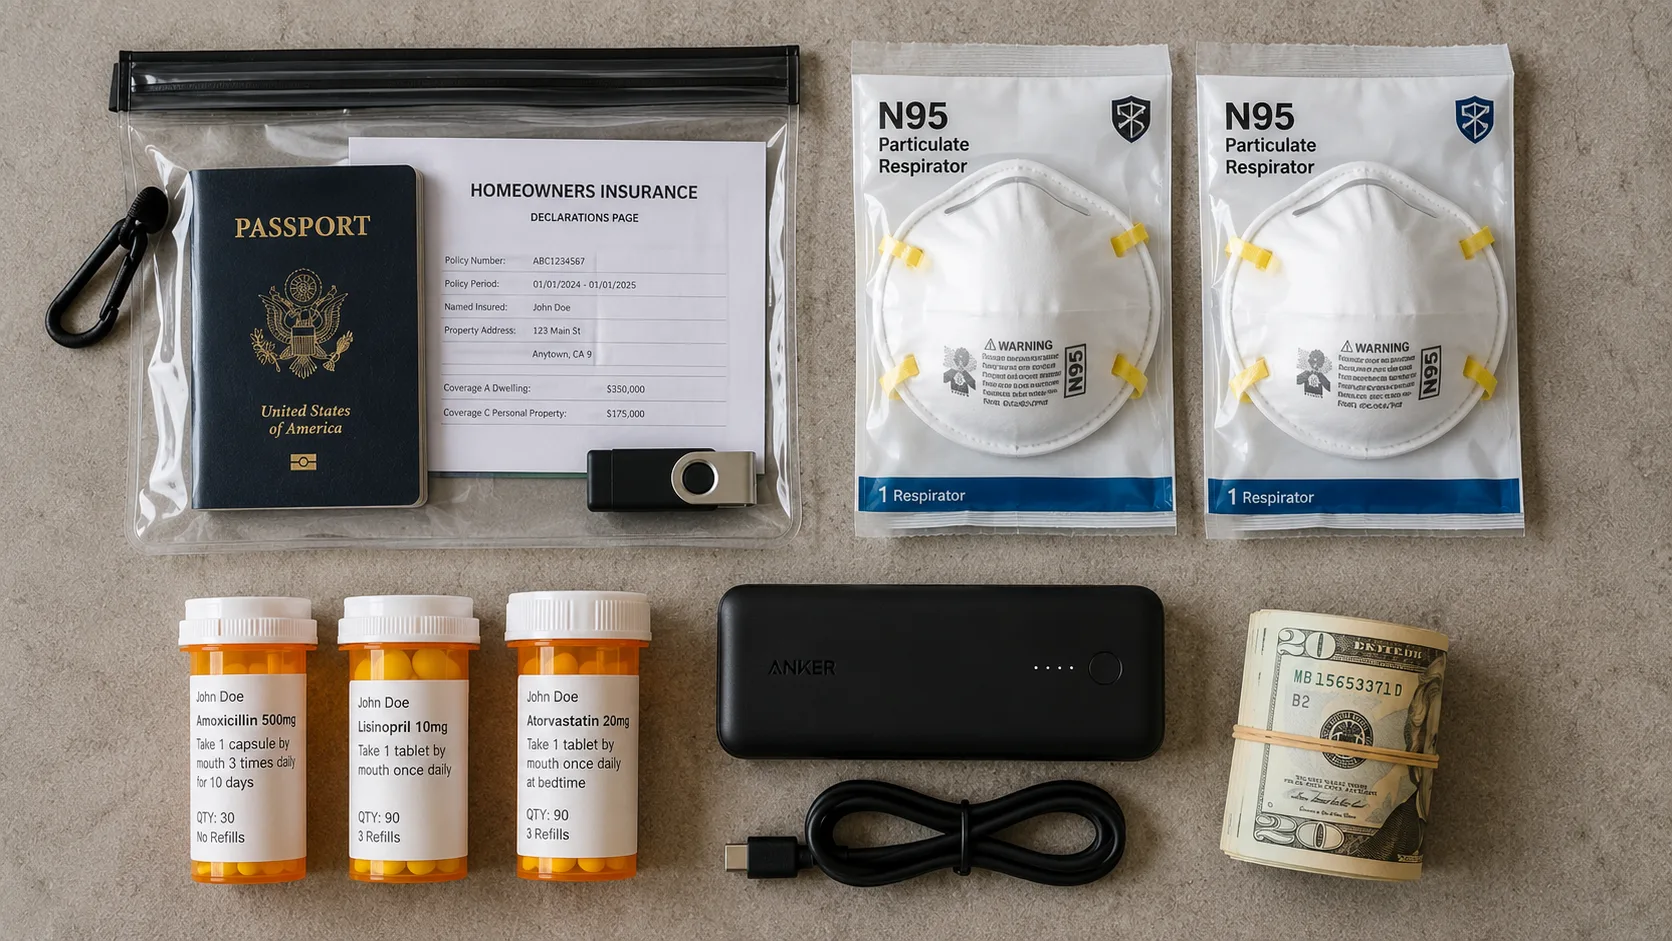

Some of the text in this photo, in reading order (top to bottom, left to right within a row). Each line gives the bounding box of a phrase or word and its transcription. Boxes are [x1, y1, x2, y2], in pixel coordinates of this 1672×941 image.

[879, 101, 948, 130] N95
[1226, 102, 1295, 130] N95
[879, 137, 970, 152] Particulate
[1226, 138, 1316, 152] Particulate
[879, 158, 968, 176] Respirator
[1226, 159, 1315, 177] Respirator
[471, 183, 698, 199] HOMEOWNERS INSURANCE
[530, 213, 639, 223] DECLARATIONS PAGE
[235, 215, 371, 238] PASSPORT
[445, 256, 585, 266] Policy Number: ABC1234567
[445, 279, 468, 289] Policy
[471, 280, 499, 289] Period:
[533, 280, 581, 290] 01/01/2024
[588, 281, 636, 290] 01/01/2025
[444, 303, 571, 312] Named Insured: John Doe
[444, 326, 581, 336] Property Address: 123 Main St
[998, 340, 1053, 351] WARNING
[1355, 342, 1409, 353] WARNING
[532, 350, 592, 360] Anytown, CA 9
[1068, 350, 1083, 392] N95
[1423, 351, 1438, 395] N95
[444, 384, 645, 395] Coverage A Dwelling: $350,000
[261, 405, 351, 418] United States
[443, 408, 645, 419] Coverage C Personal Property: $175,000
[269, 422, 343, 438] of America
[878, 486, 966, 504] 1 Respirator
[1228, 488, 1315, 506] 1 Respirator
[1278, 627, 1336, 660] 20
[768, 660, 836, 675] ANKER
[196, 691, 244, 703] John Doe
[358, 697, 410, 709] John Doe
[526, 690, 579, 703] John Doe
[1292, 694, 1310, 708] B2
[196, 714, 296, 727] Amoxicillin 500mg
[526, 715, 630, 728] Atorvastatin 20mg
[358, 721, 448, 735] Lisinopril 10mg
[196, 737, 290, 752] Take 1 capsule by
[358, 744, 446, 758] Take 1 tablet by
[527, 738, 614, 752] Take 1 tablet by
[196, 756, 296, 769] mouth 3 times daily
[527, 757, 621, 771] mouth once daily
[358, 763, 451, 777] mouth once daily
[196, 776, 254, 791] for 10 days
[526, 777, 586, 788] at bedtime
[196, 811, 235, 824] QTY: 30
[358, 811, 400, 823] QTY: 90
[526, 808, 569, 821] QTY: 90
[196, 831, 245, 843] No Refills
[358, 830, 400, 843] 3 Refills
[526, 828, 570, 840] 3 Refills
[1253, 812, 1345, 851] 20
